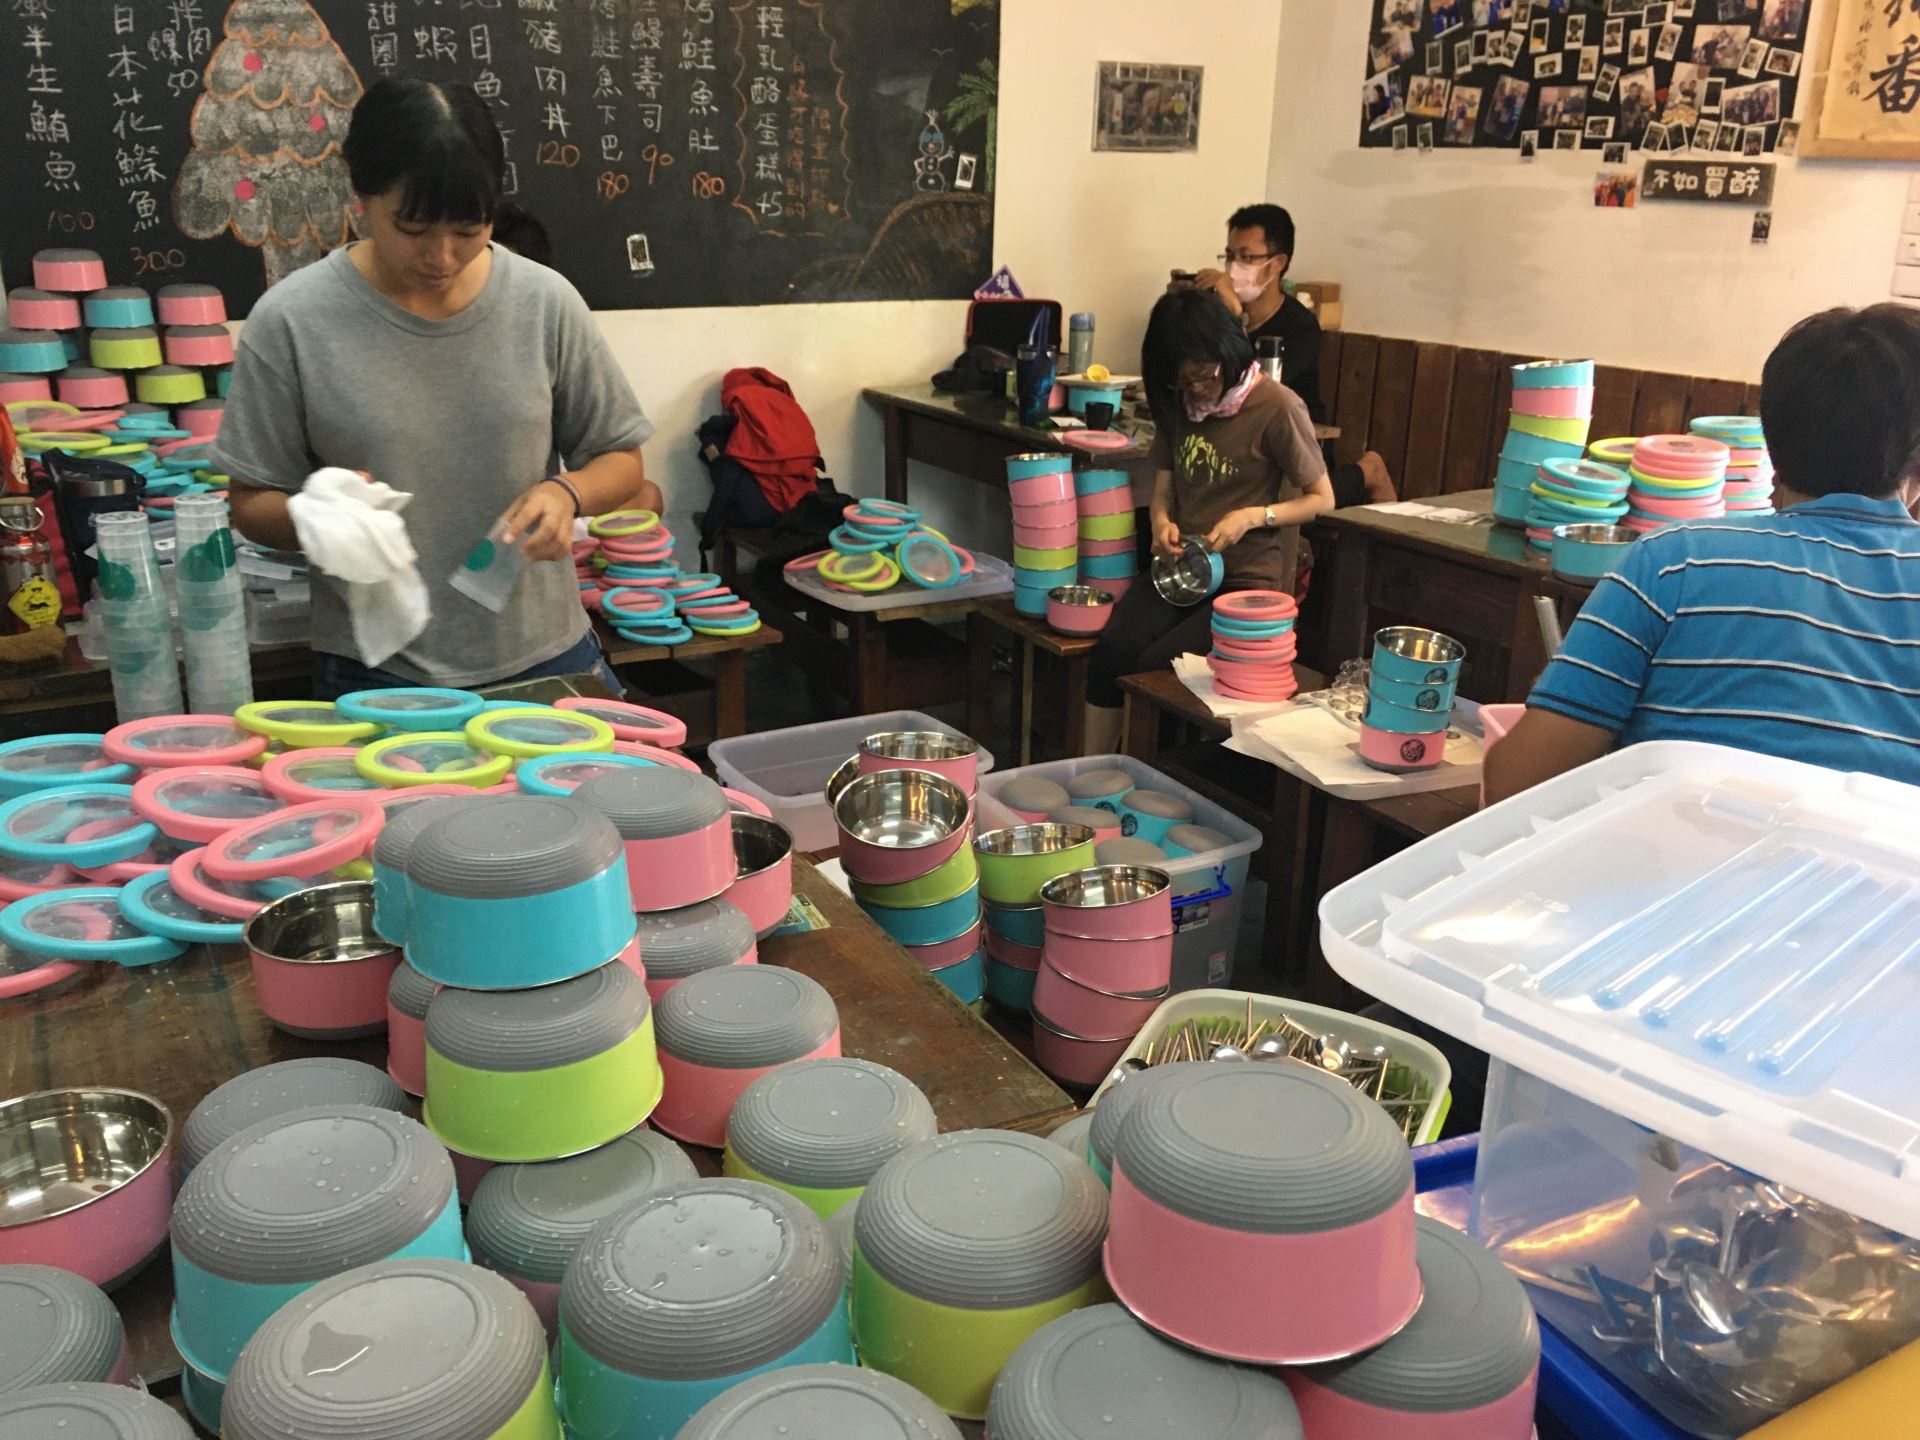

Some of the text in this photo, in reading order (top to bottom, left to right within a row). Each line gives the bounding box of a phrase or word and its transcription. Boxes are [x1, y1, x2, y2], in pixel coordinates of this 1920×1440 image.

[168, 69, 198, 97] 50
[536, 140, 581, 168] 120
[641, 143, 674, 185] 90
[597, 171, 630, 199] 180
[692, 171, 725, 199] 180
[1652, 165, 1762, 198] 不如買醉
[48, 211, 95, 233] 100
[130, 247, 186, 275] 300
